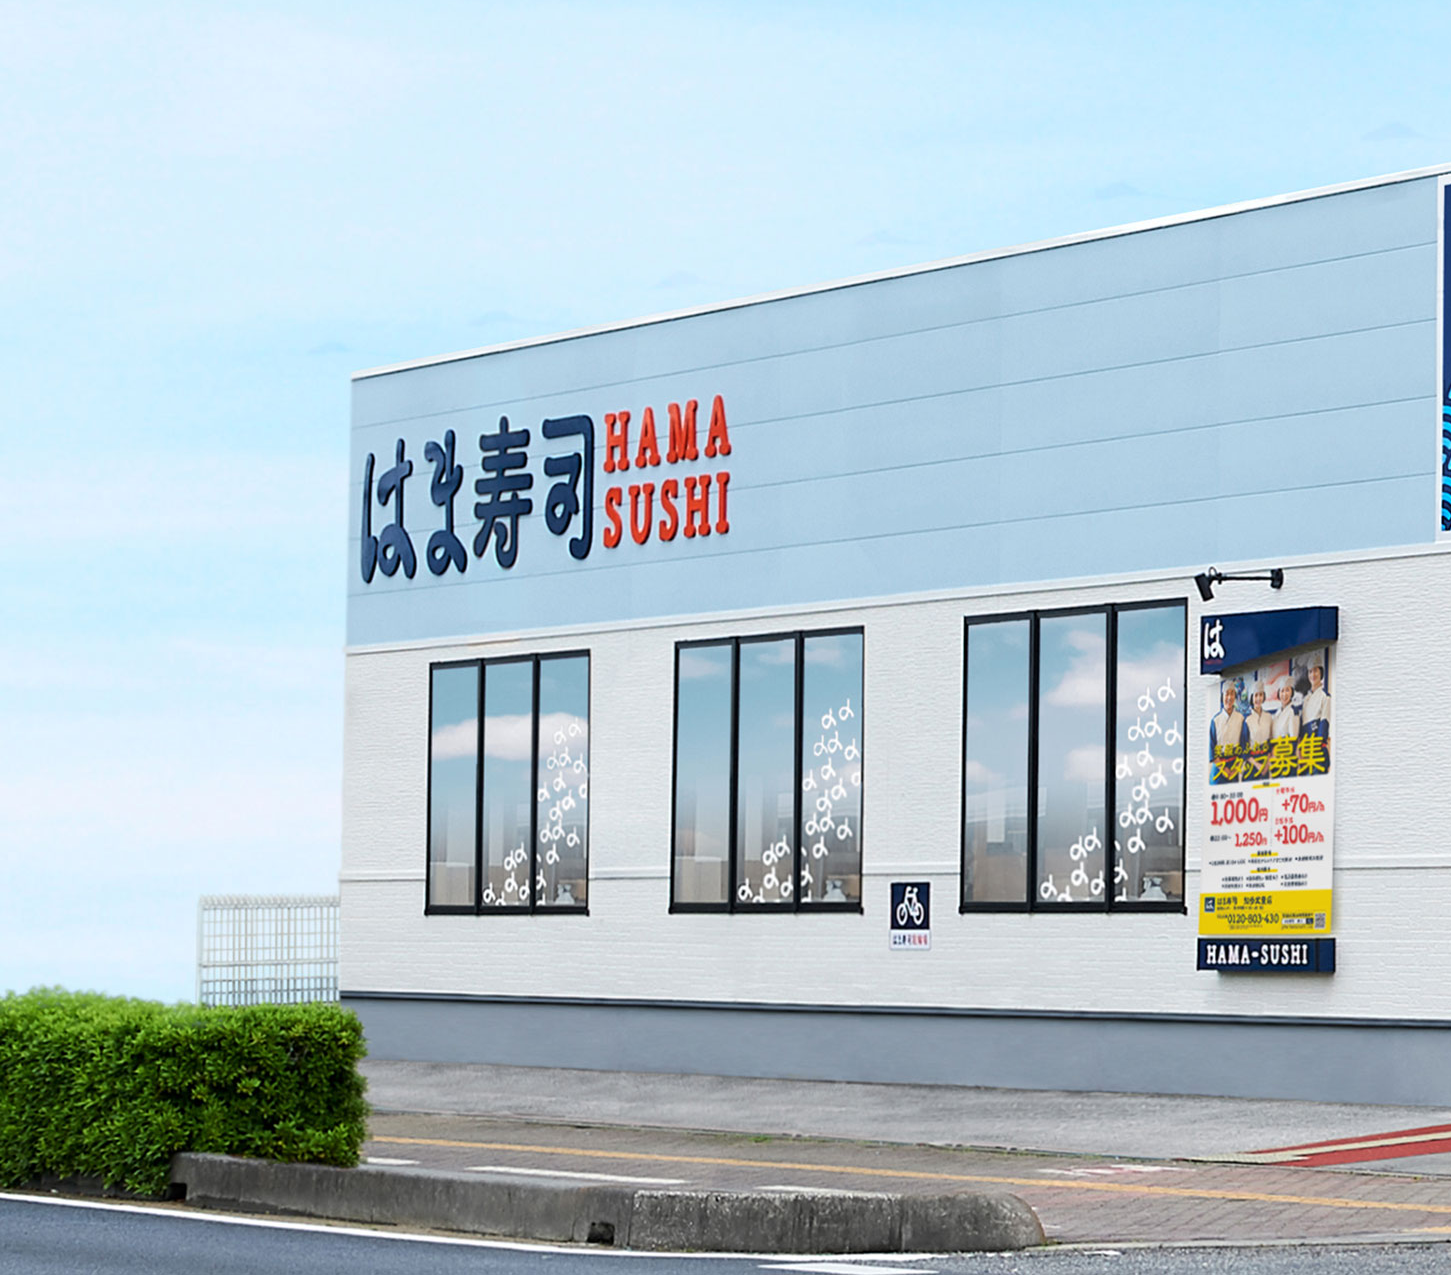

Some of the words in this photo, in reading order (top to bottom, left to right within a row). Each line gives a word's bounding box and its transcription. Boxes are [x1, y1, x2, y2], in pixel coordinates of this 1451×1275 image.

[603, 395, 732, 472] HAMA
[361, 415, 595, 584] はま寿司
[603, 471, 731, 548] SUSHI
[1204, 619, 1225, 659] は
[1212, 732, 1326, 781] スタッフ募集
[1210, 797, 1269, 826] 1,000円
[1206, 944, 1308, 965] HAMA-SUSHI
